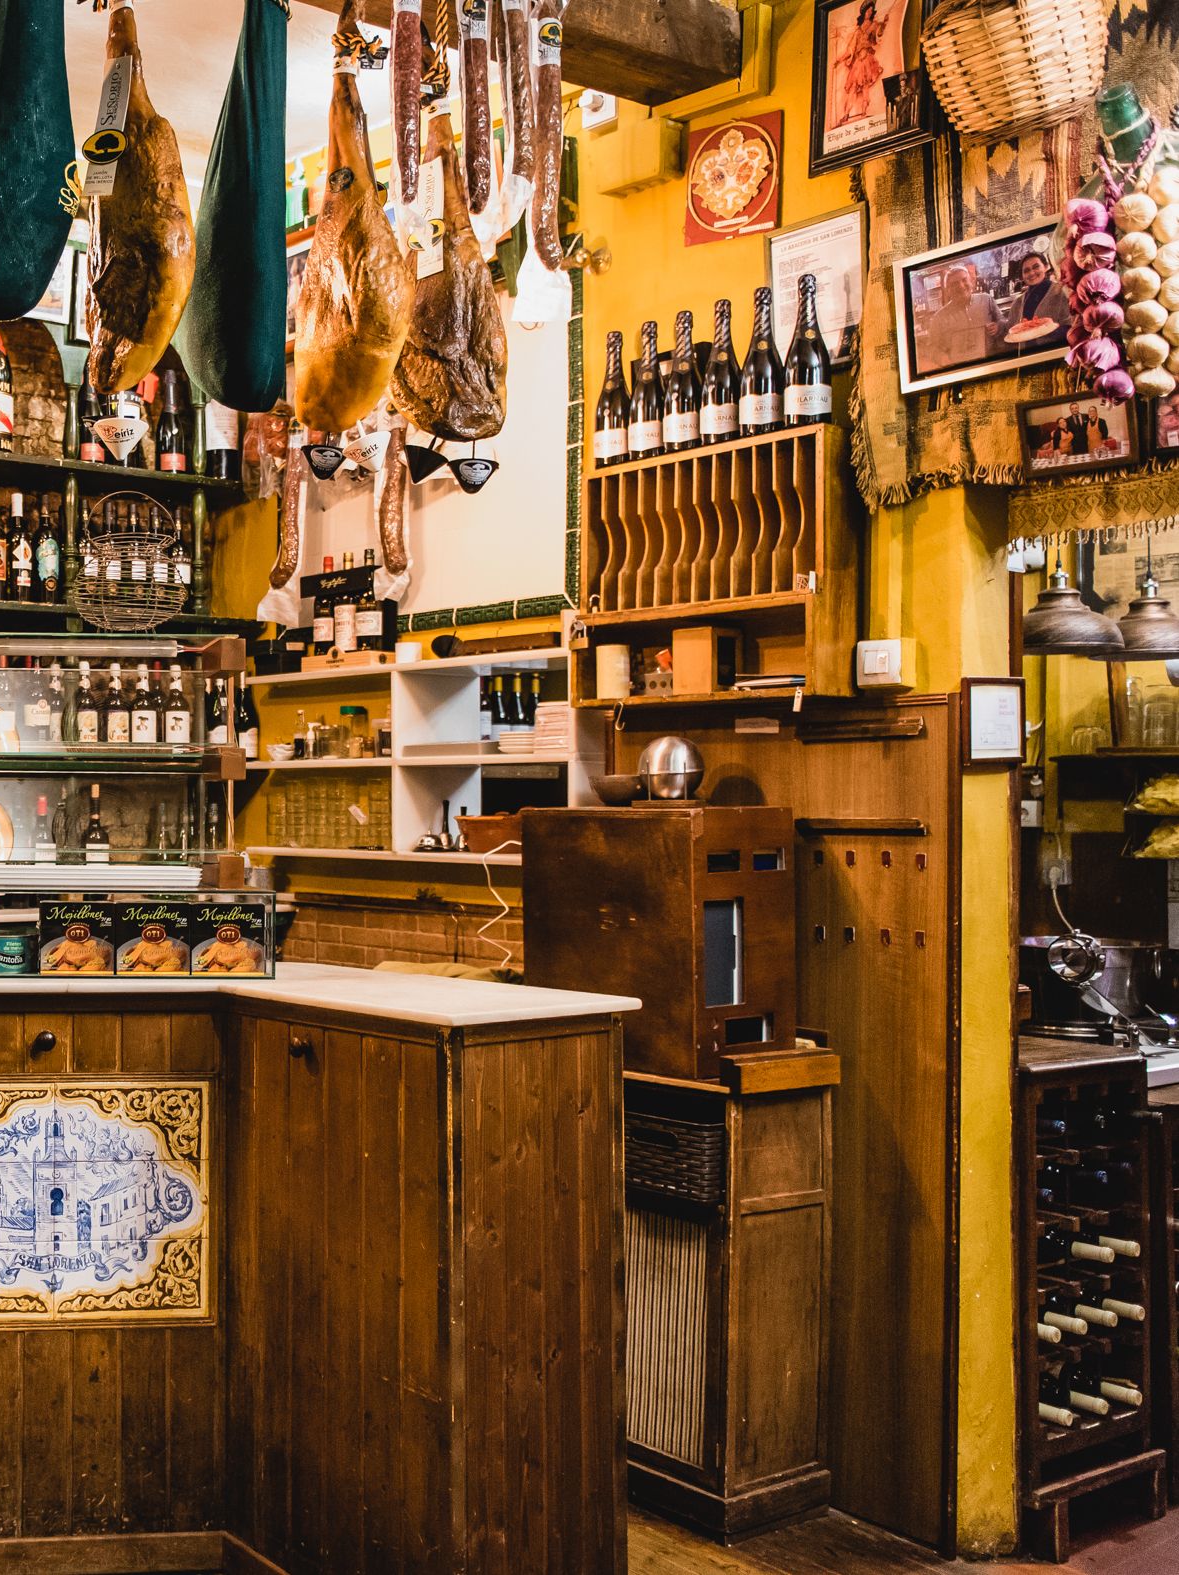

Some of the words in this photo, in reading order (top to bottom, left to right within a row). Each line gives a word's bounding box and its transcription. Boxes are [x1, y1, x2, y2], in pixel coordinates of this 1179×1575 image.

[46, 905, 104, 926] Mejillones
[122, 906, 179, 927] Mejillones
[197, 907, 254, 928] Mejillones
[47, 1251, 97, 1270] LORENZO
